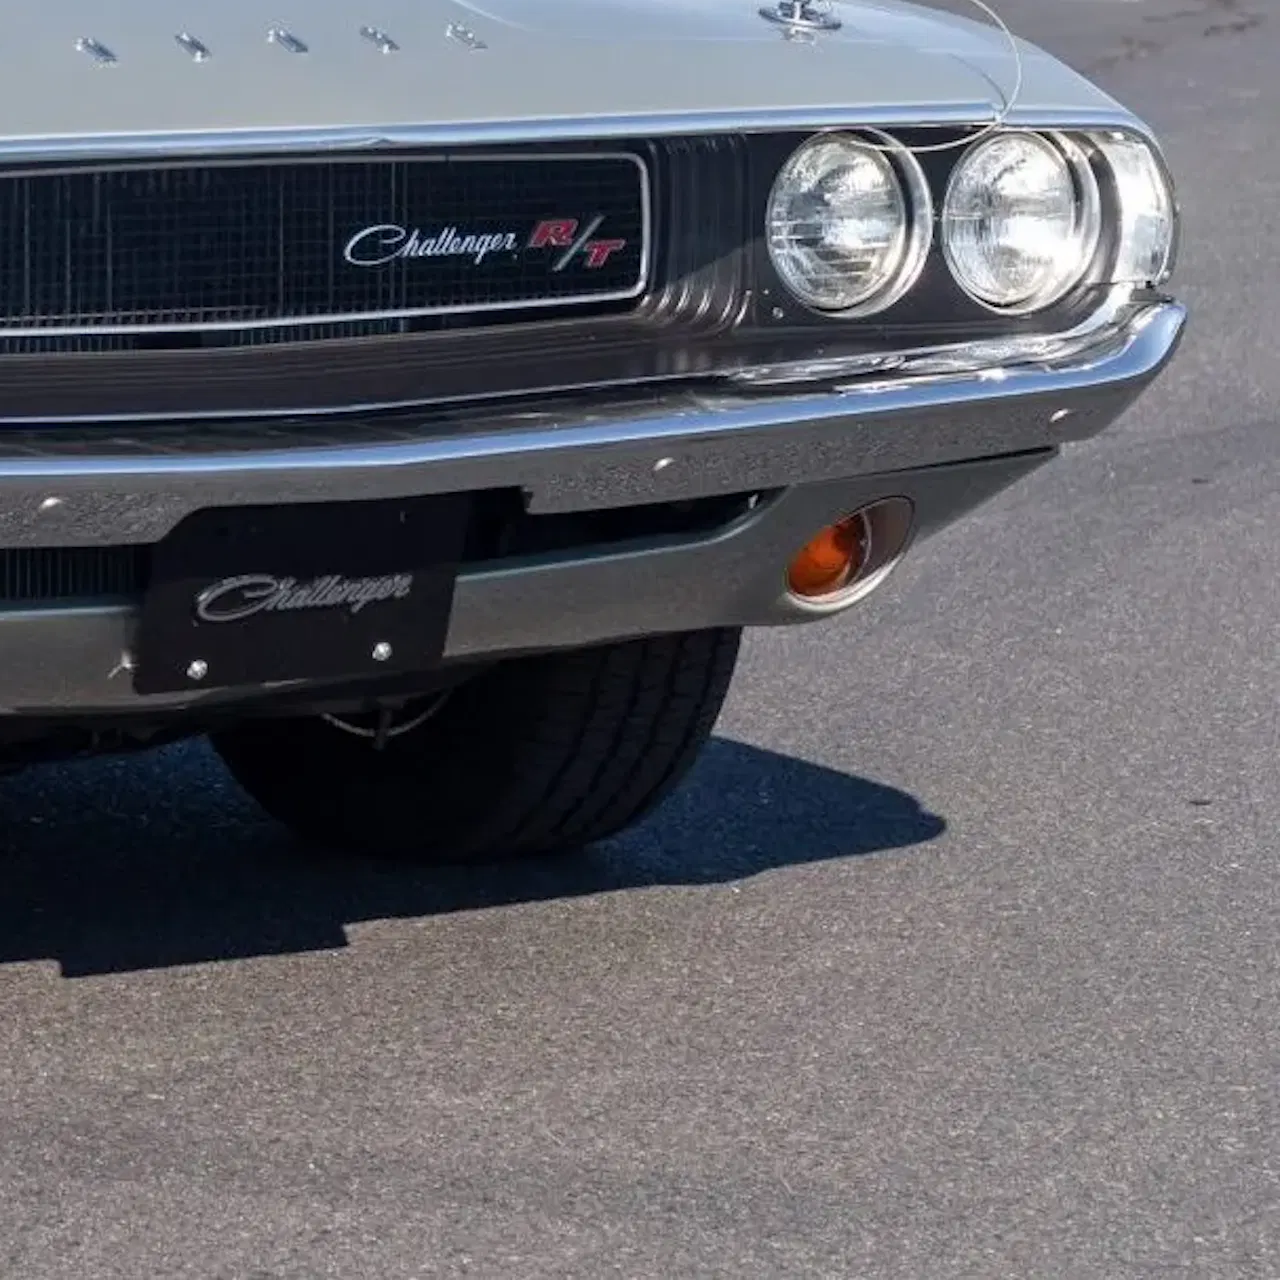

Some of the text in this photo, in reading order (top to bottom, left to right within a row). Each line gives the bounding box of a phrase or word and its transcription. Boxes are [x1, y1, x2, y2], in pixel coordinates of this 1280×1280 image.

[344, 215, 627, 272] Challenger R/T
[196, 573, 414, 621] Challenger
